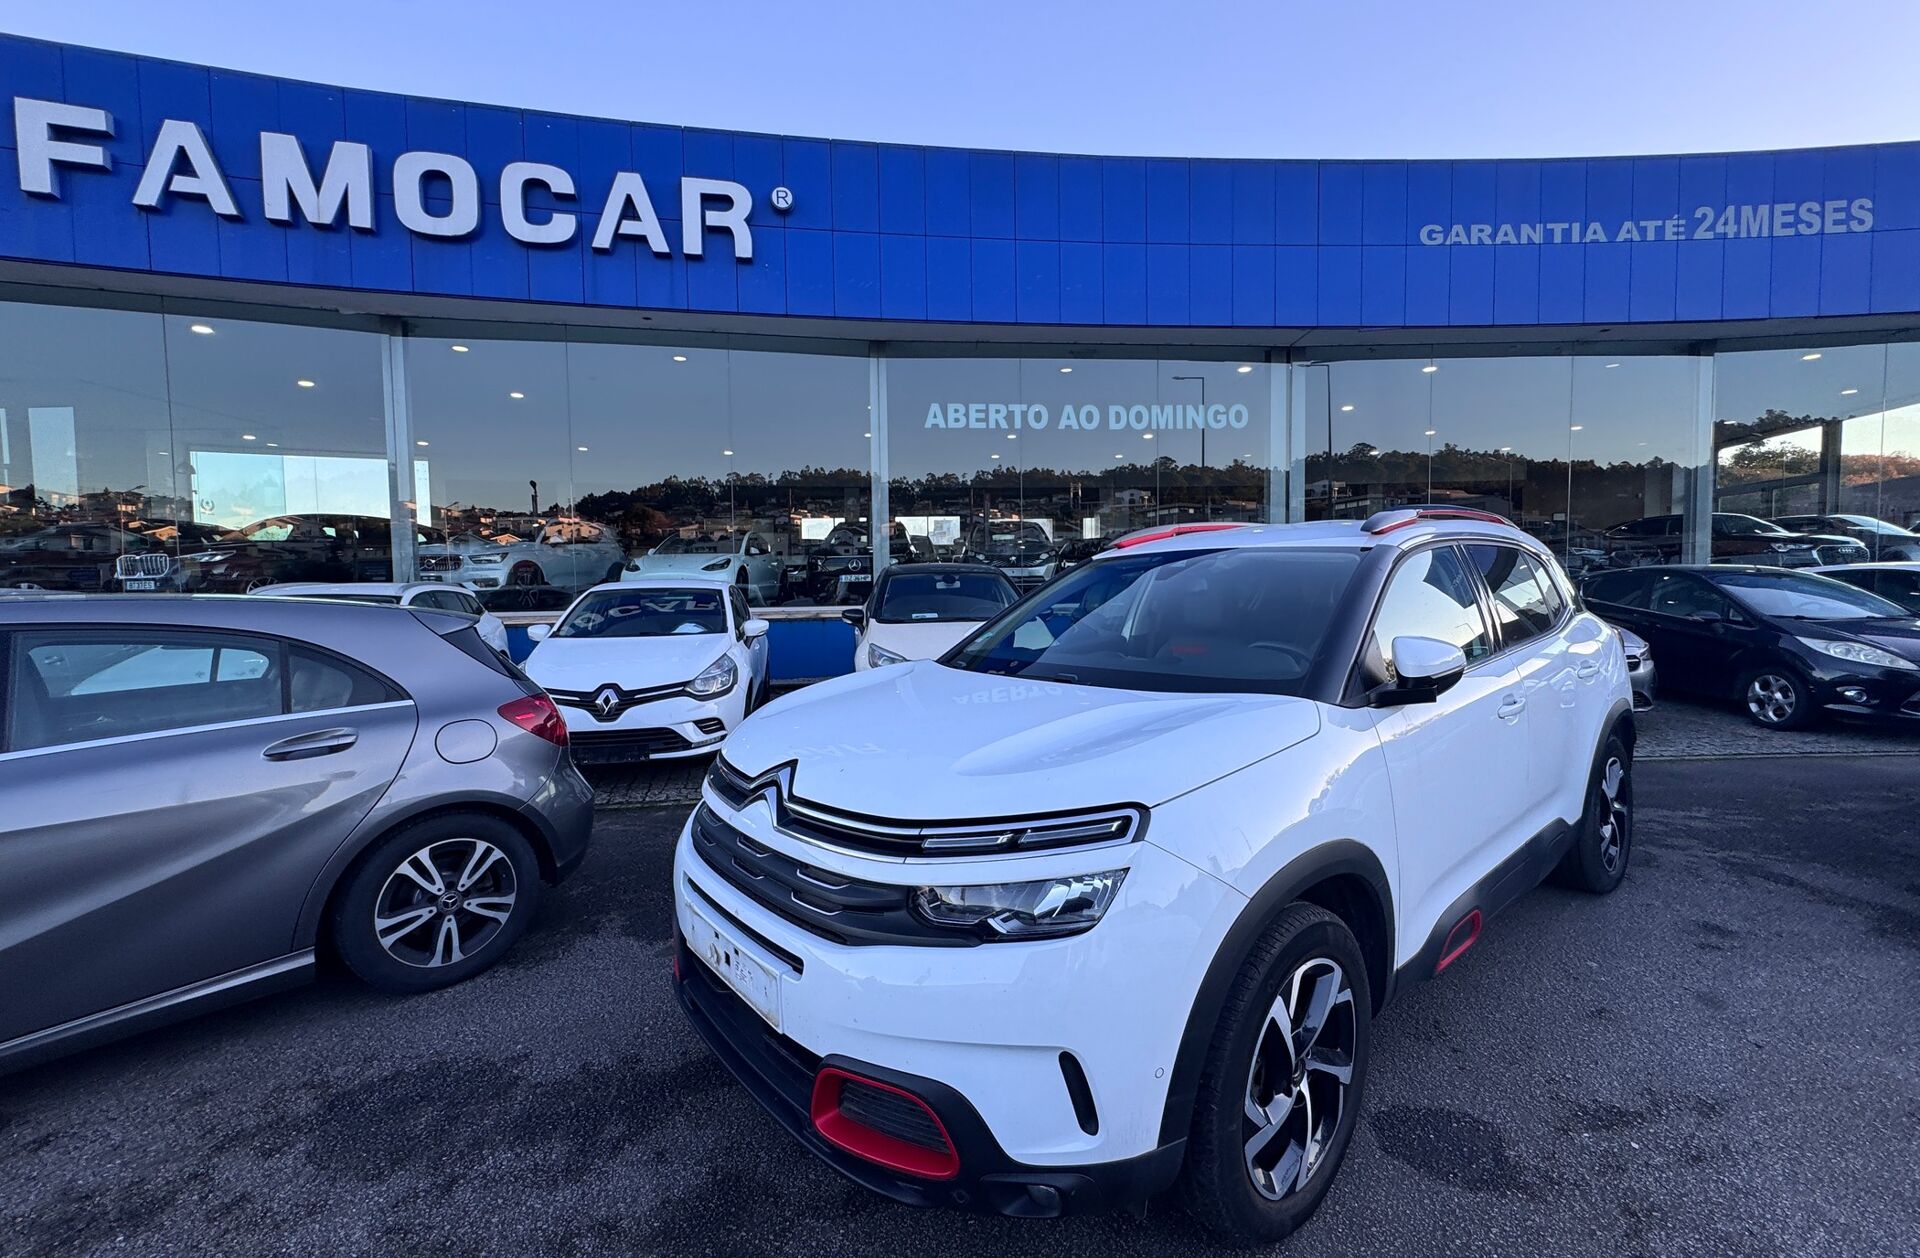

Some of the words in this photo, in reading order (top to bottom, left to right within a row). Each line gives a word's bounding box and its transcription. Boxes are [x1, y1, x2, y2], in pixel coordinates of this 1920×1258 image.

[13, 97, 755, 261] FAMOCAR
[1418, 222, 1607, 246] GARANTIA
[1615, 214, 1687, 242] ATÉ
[1693, 198, 1875, 240] 24MESES
[924, 402, 1049, 430] ABERTO
[1057, 403, 1101, 430] AO
[1108, 404, 1249, 431] DOMINGO
